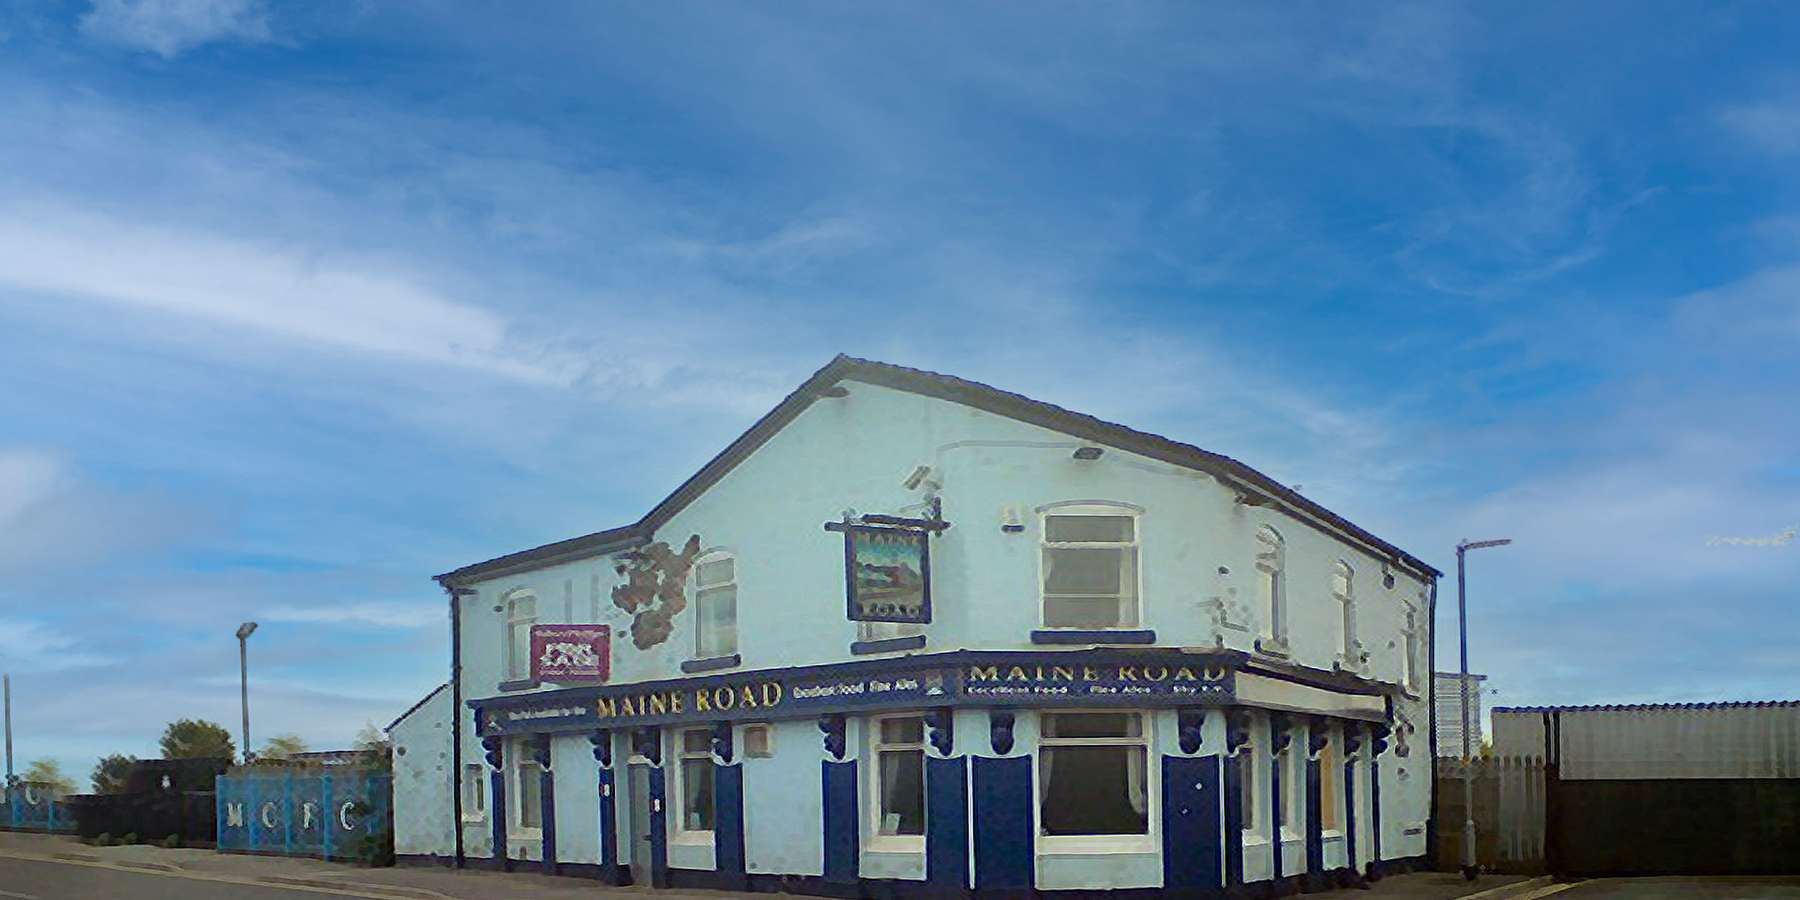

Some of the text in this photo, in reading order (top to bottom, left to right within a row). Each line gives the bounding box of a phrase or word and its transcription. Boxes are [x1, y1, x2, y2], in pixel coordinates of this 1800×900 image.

[970, 666, 1226, 681] MAINE ROAD
[598, 690, 684, 718] MAINE
[696, 682, 782, 711] ROAD
